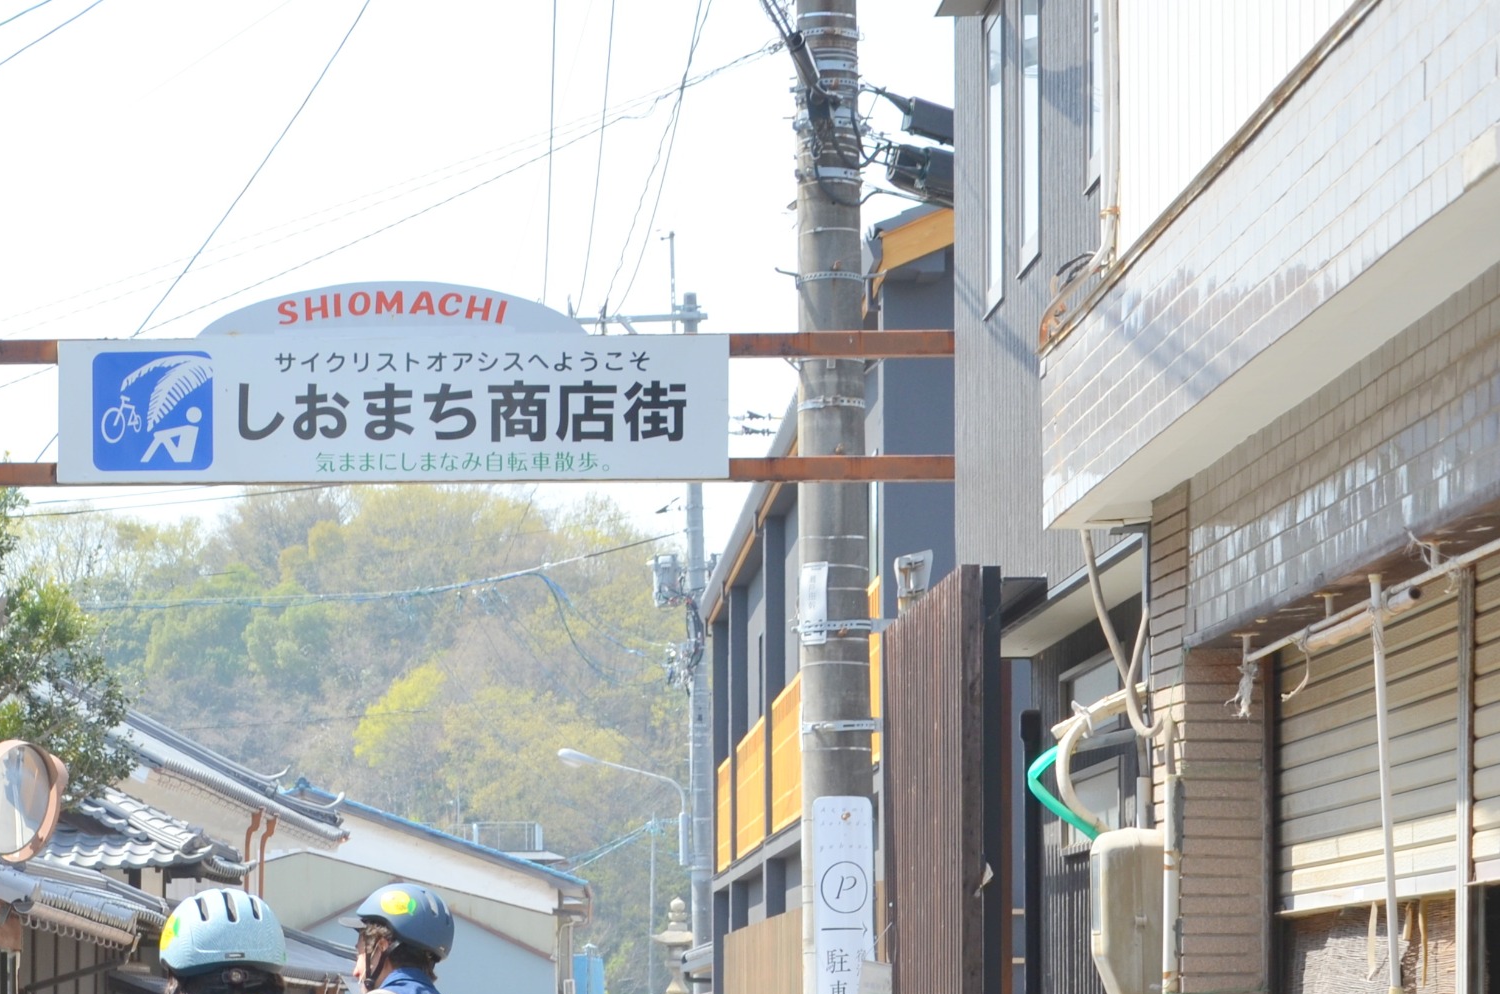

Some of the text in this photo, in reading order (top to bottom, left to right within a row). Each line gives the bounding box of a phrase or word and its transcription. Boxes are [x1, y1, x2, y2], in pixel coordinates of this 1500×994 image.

[277, 290, 508, 325] SHIOMACHI
[274, 351, 650, 373] サイクリストオアシスへようこそ
[238, 380, 687, 442] しおまち商店街
[315, 452, 611, 473] 気ままにしまなみ自転車散歩。
[835, 875, 857, 899] P
